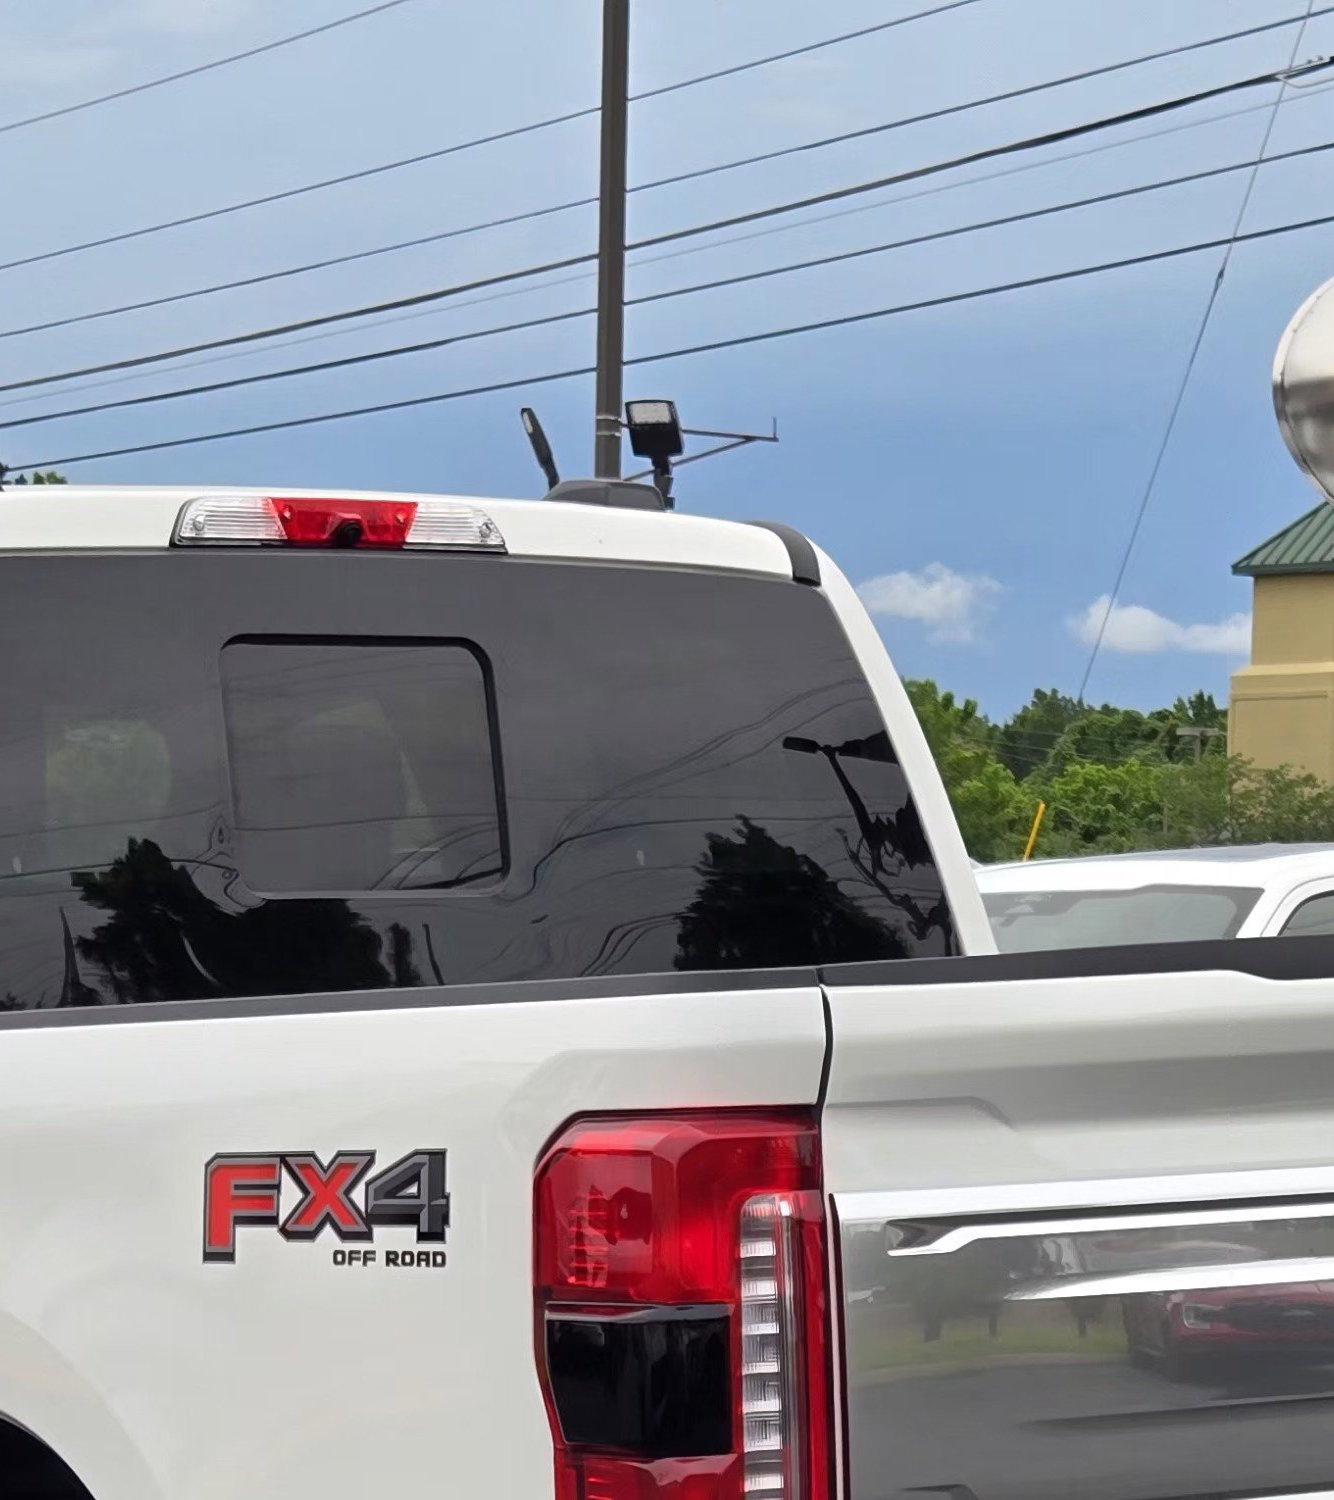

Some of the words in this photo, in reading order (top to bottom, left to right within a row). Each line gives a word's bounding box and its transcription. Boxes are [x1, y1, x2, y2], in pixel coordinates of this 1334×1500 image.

[202, 1148, 450, 1264] FX4
[333, 1249, 376, 1267] OFF
[385, 1250, 447, 1268] ROAD
